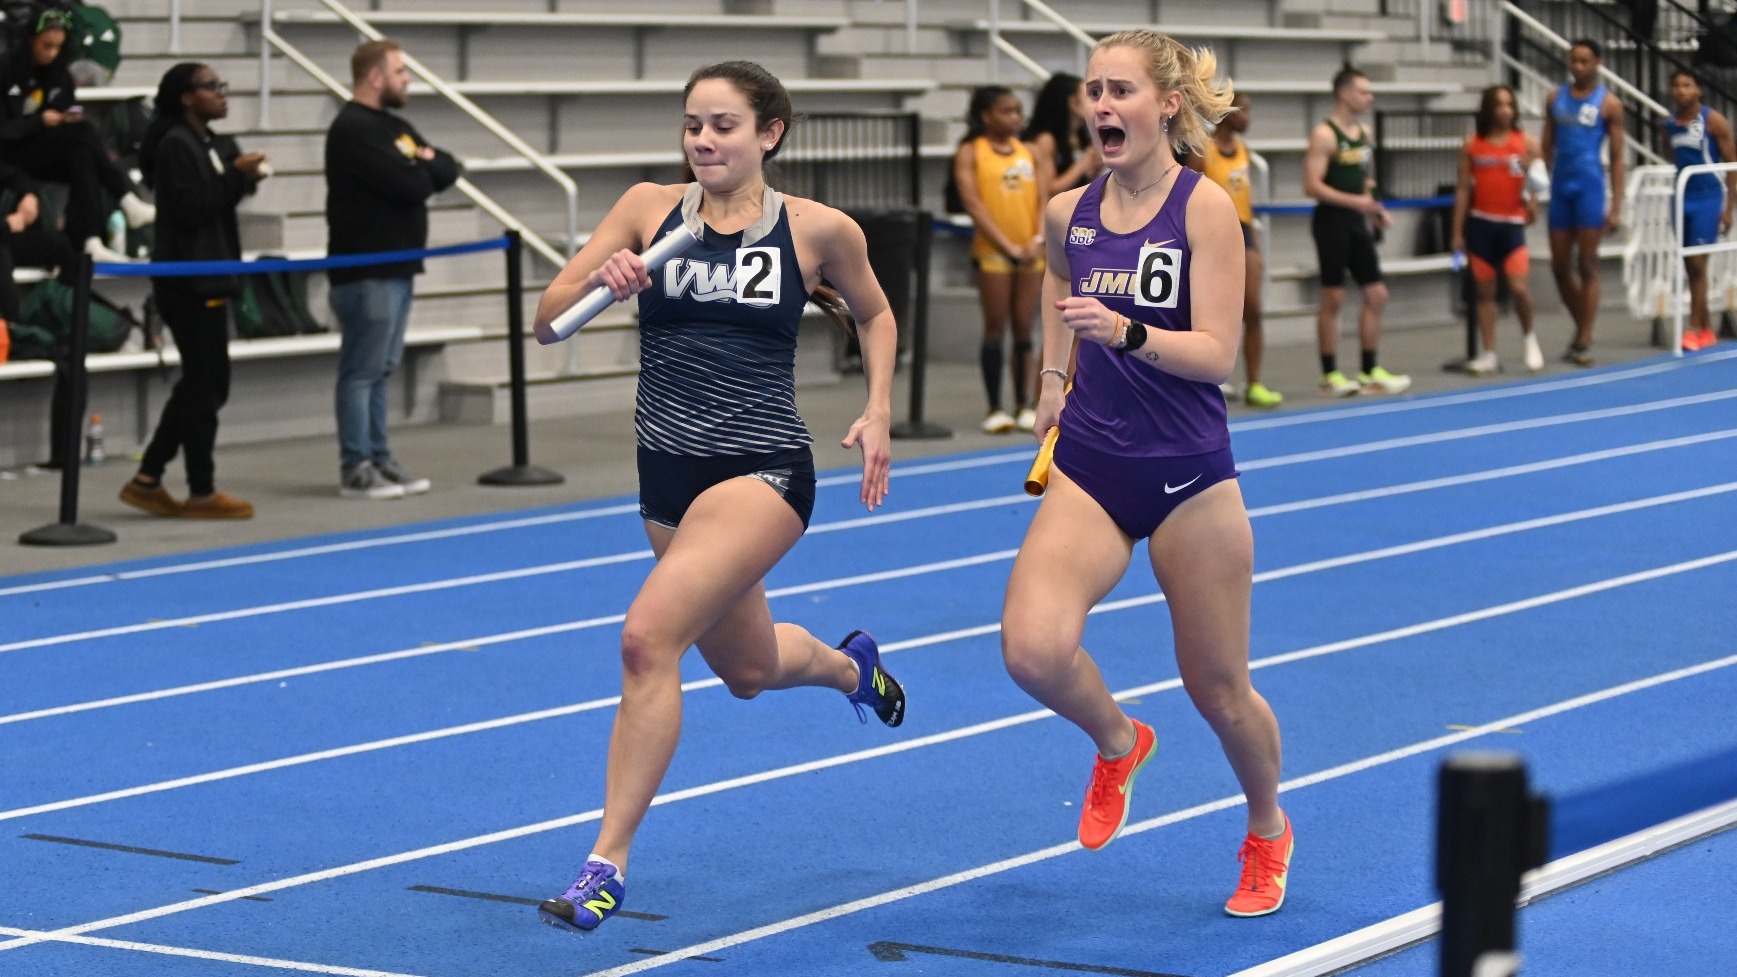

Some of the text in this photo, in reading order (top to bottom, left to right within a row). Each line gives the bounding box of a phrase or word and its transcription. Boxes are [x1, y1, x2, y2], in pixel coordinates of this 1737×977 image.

[664, 258, 738, 303] VW
[742, 251, 773, 299] 2
[1141, 252, 1173, 303] 6
[583, 890, 616, 920] N
